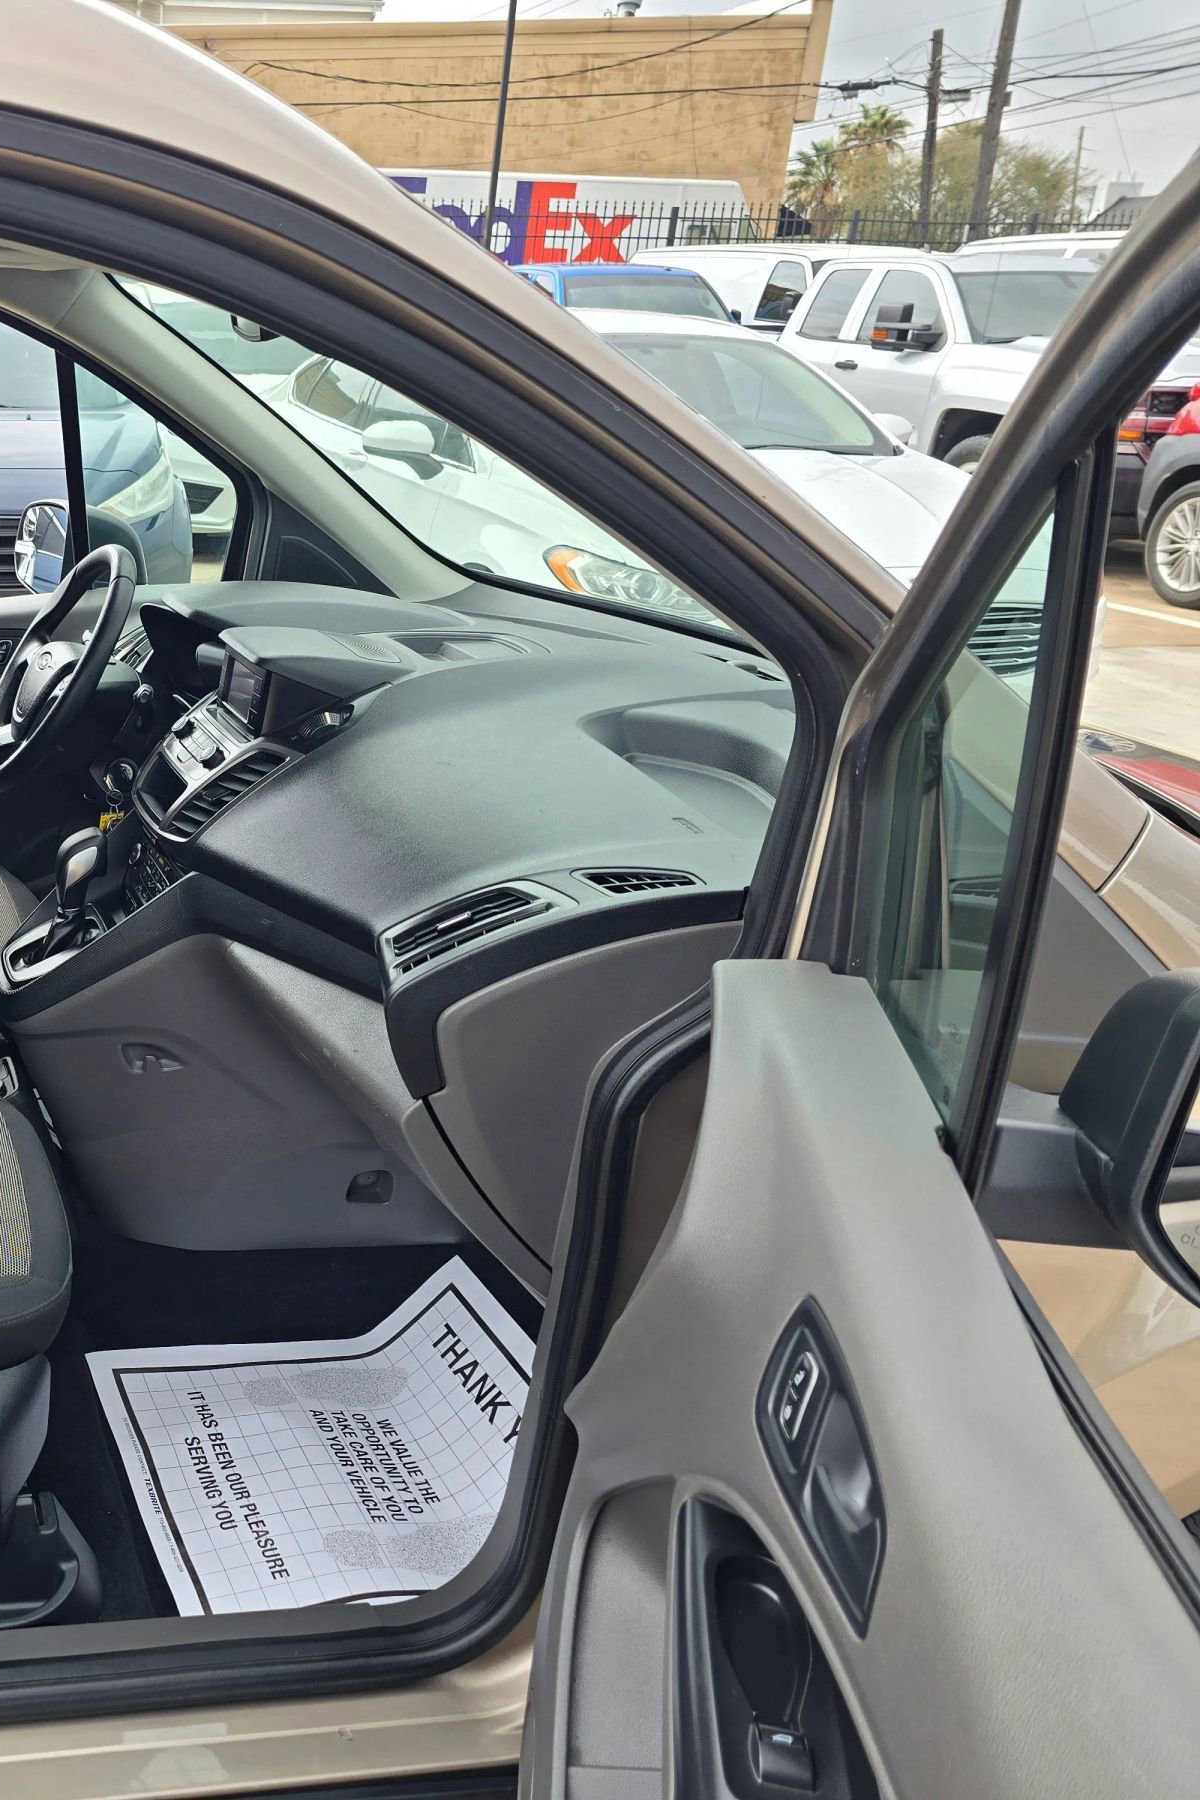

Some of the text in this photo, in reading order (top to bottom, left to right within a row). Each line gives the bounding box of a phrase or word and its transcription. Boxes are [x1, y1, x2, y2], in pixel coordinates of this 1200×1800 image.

[432, 1322, 512, 1425] THANK
[144, 1477, 162, 1515] TEXBRITE
[184, 1436, 238, 1531] SERVING YOU
[187, 1391, 291, 1580] IT HAS BEEN OUR PLEASURE
[309, 1409, 388, 1523] AND YOUR VEHICLE
[330, 1410, 409, 1522] TAKE CARE OF YOU
[351, 1412, 424, 1515] OPPORTUNITY TO
[376, 1418, 441, 1505] WE VALUE THE
